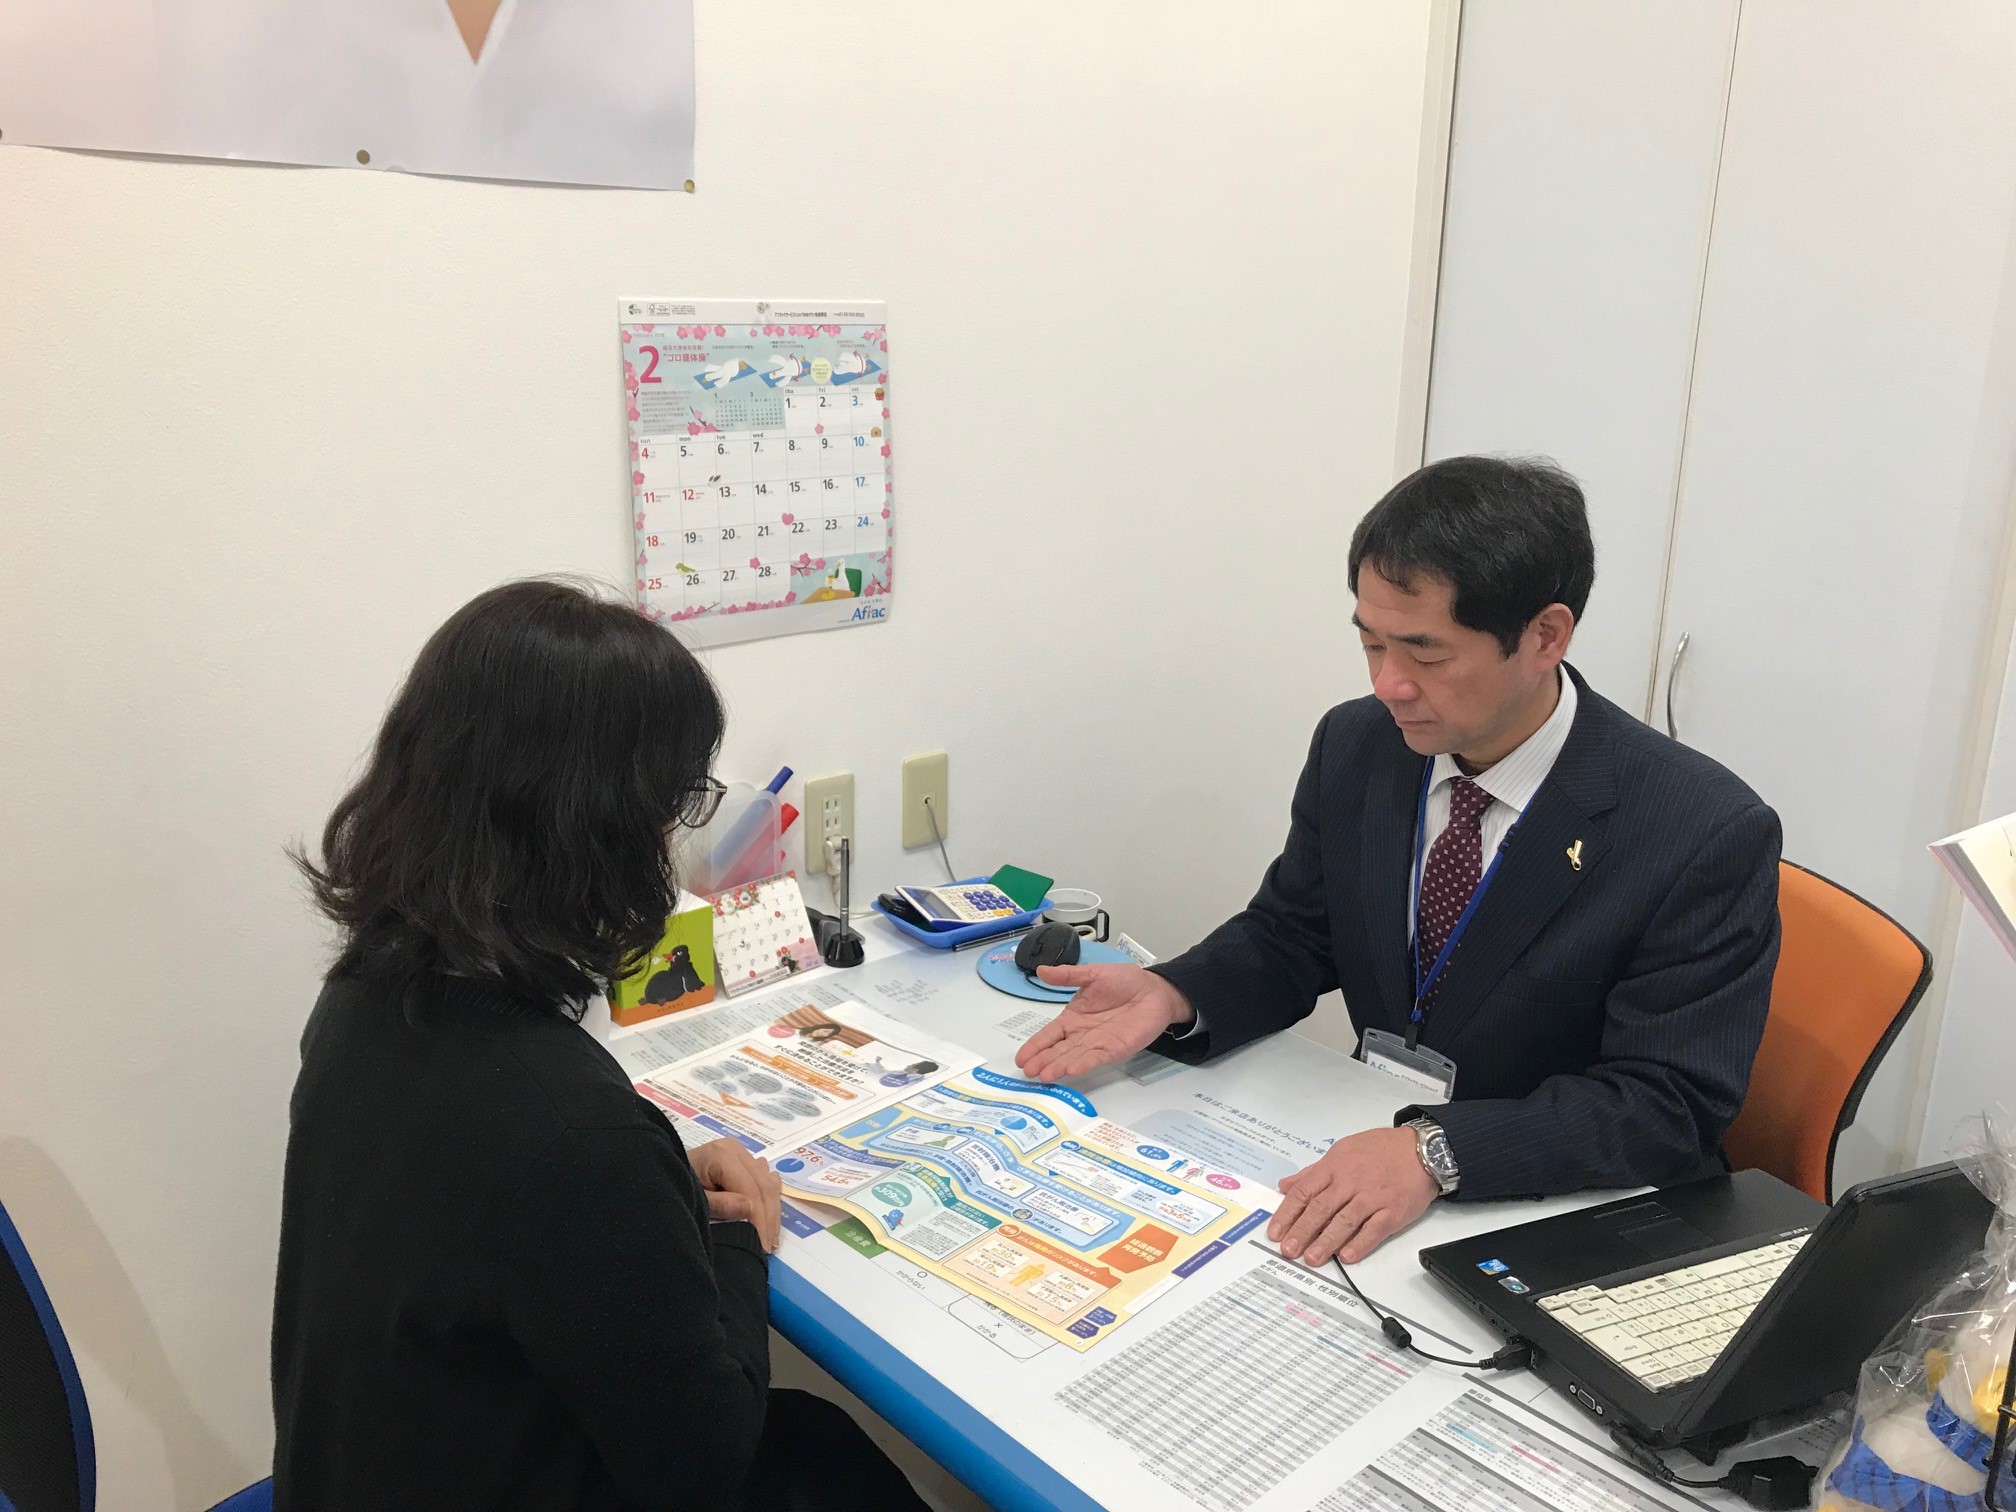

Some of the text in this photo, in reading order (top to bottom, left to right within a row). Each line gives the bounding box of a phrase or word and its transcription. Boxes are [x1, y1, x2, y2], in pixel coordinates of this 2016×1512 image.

[640, 346, 662, 383] 2
[786, 396, 858, 408] 1 2 3
[642, 436, 864, 459] 4 5 6 7 8 9 10
[644, 477, 865, 503] 11 12 13 14 15 16 17
[646, 517, 868, 547] 18 19 20 21 22 23 24
[648, 567, 771, 589] 25 26 27 28
[851, 605, 886, 620] Aflac
[1116, 939, 1134, 958] Aflac
[970, 1143, 1000, 1171] 放射線治療
[1037, 1191, 1080, 1212] 抗がん剤治療
[896, 1269, 925, 1292] かからない
[976, 1323, 997, 1341] かかる
[1623, 1344, 1638, 1352] Enter
